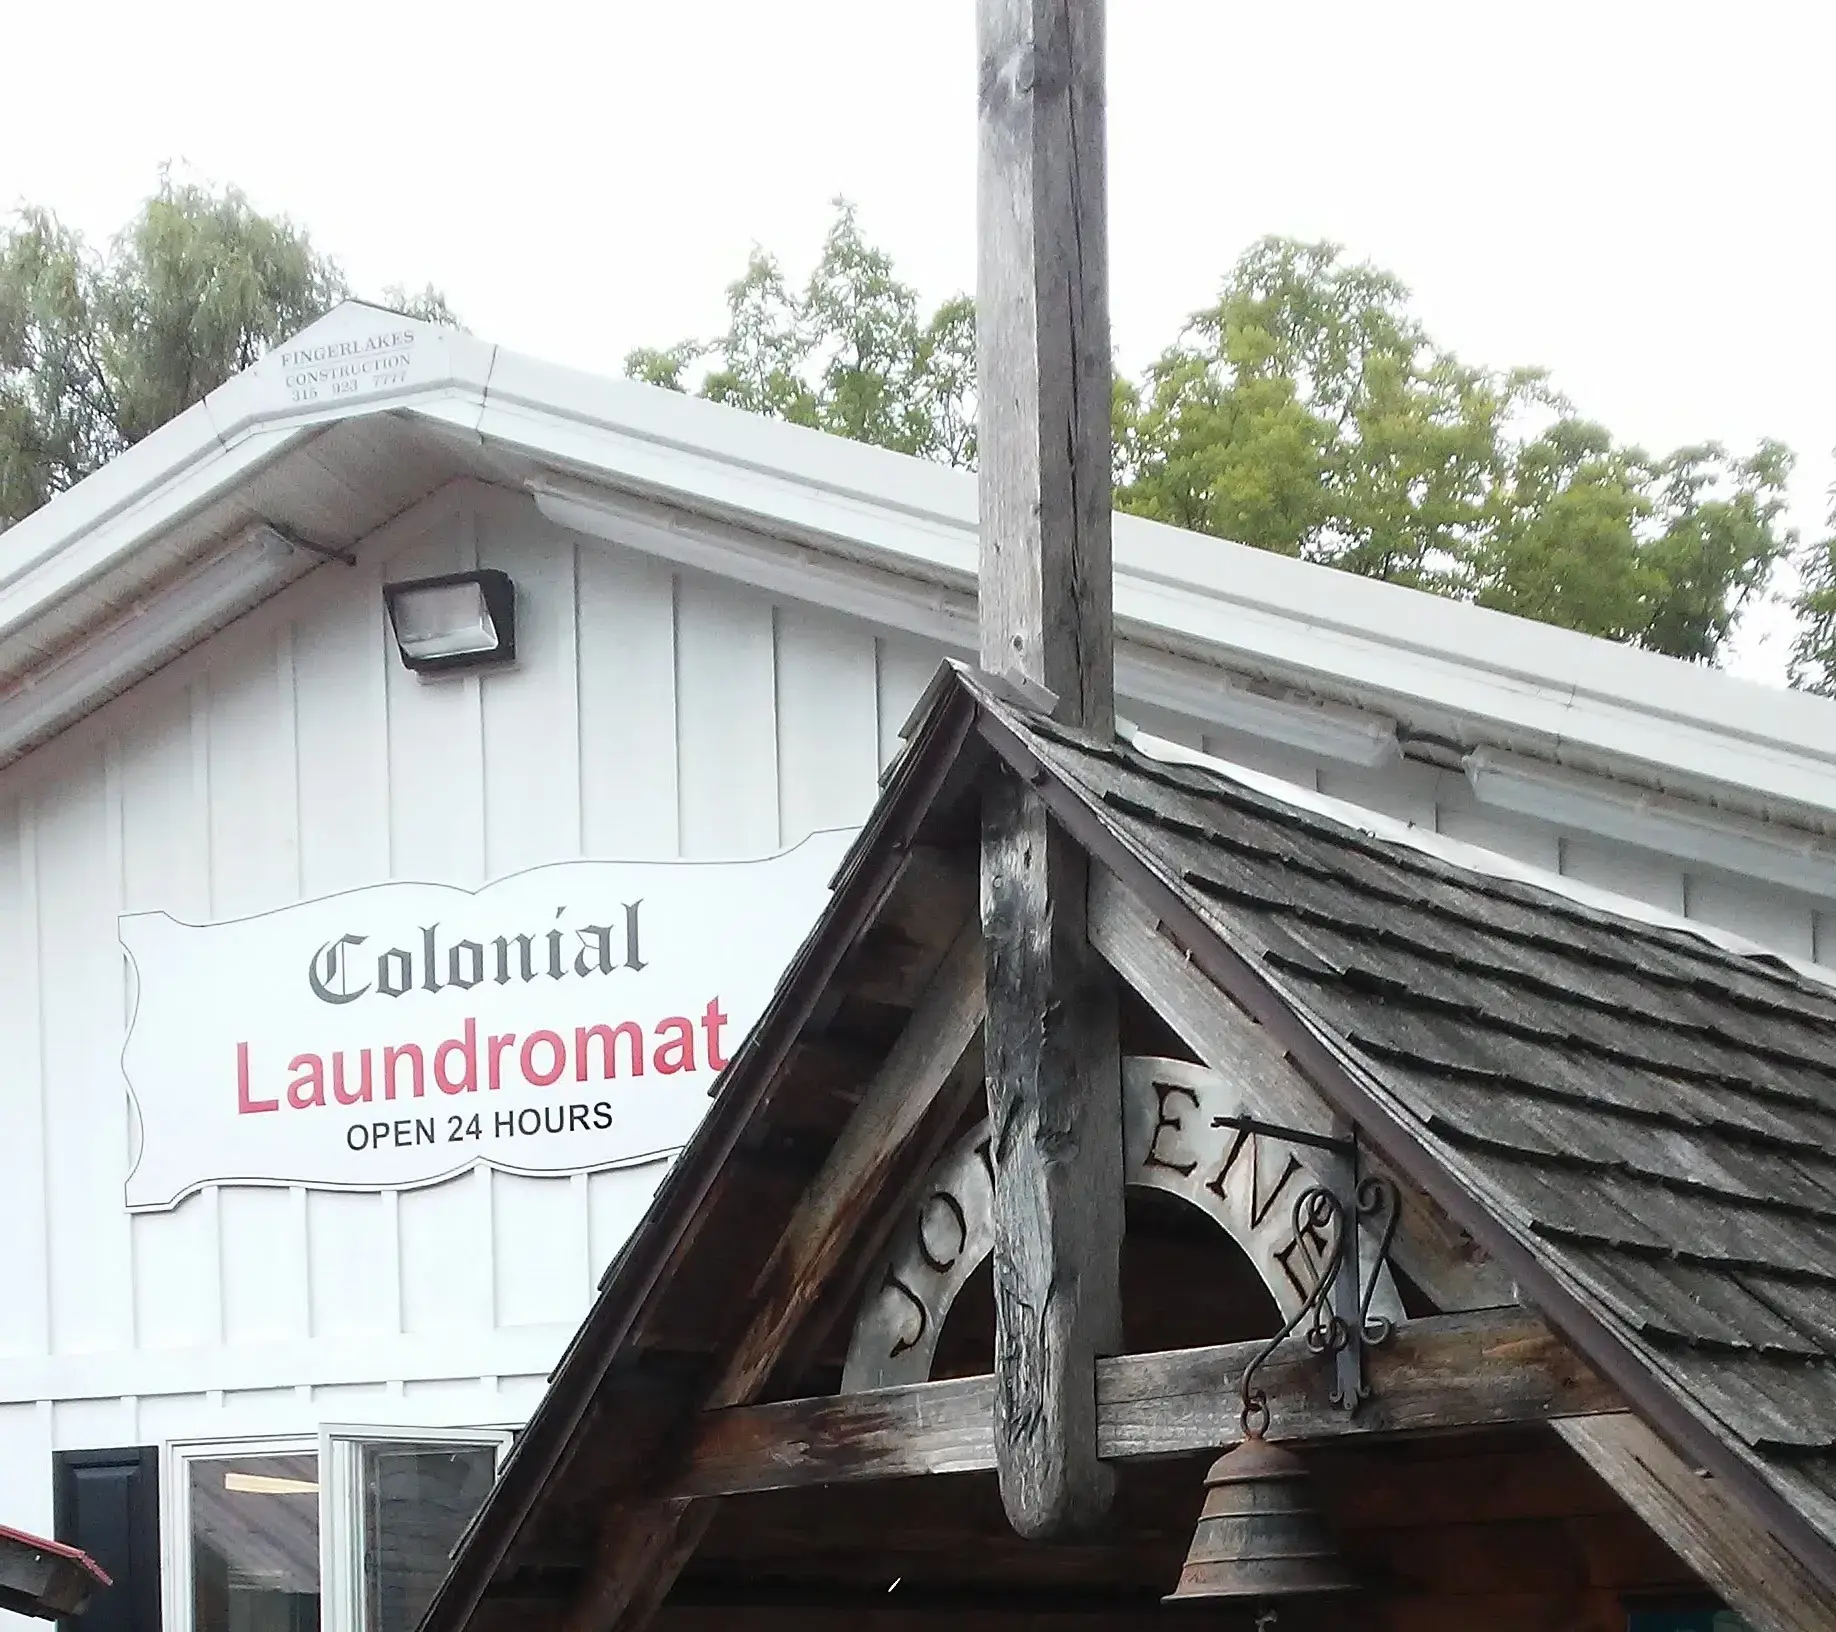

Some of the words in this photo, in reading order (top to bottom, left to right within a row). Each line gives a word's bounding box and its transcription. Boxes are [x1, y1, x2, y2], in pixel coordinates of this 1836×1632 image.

[281, 329, 415, 367] FINGERLAKES
[286, 353, 412, 387] CONSTRUCTION
[291, 387, 318, 402] 315
[332, 379, 358, 396] 923
[372, 371, 406, 388] 7777
[309, 898, 649, 1005] Colonial
[236, 995, 730, 1116] Laundromat
[346, 1118, 436, 1152] OPEN
[447, 1113, 484, 1143] 24
[494, 1101, 613, 1139] HOURS
